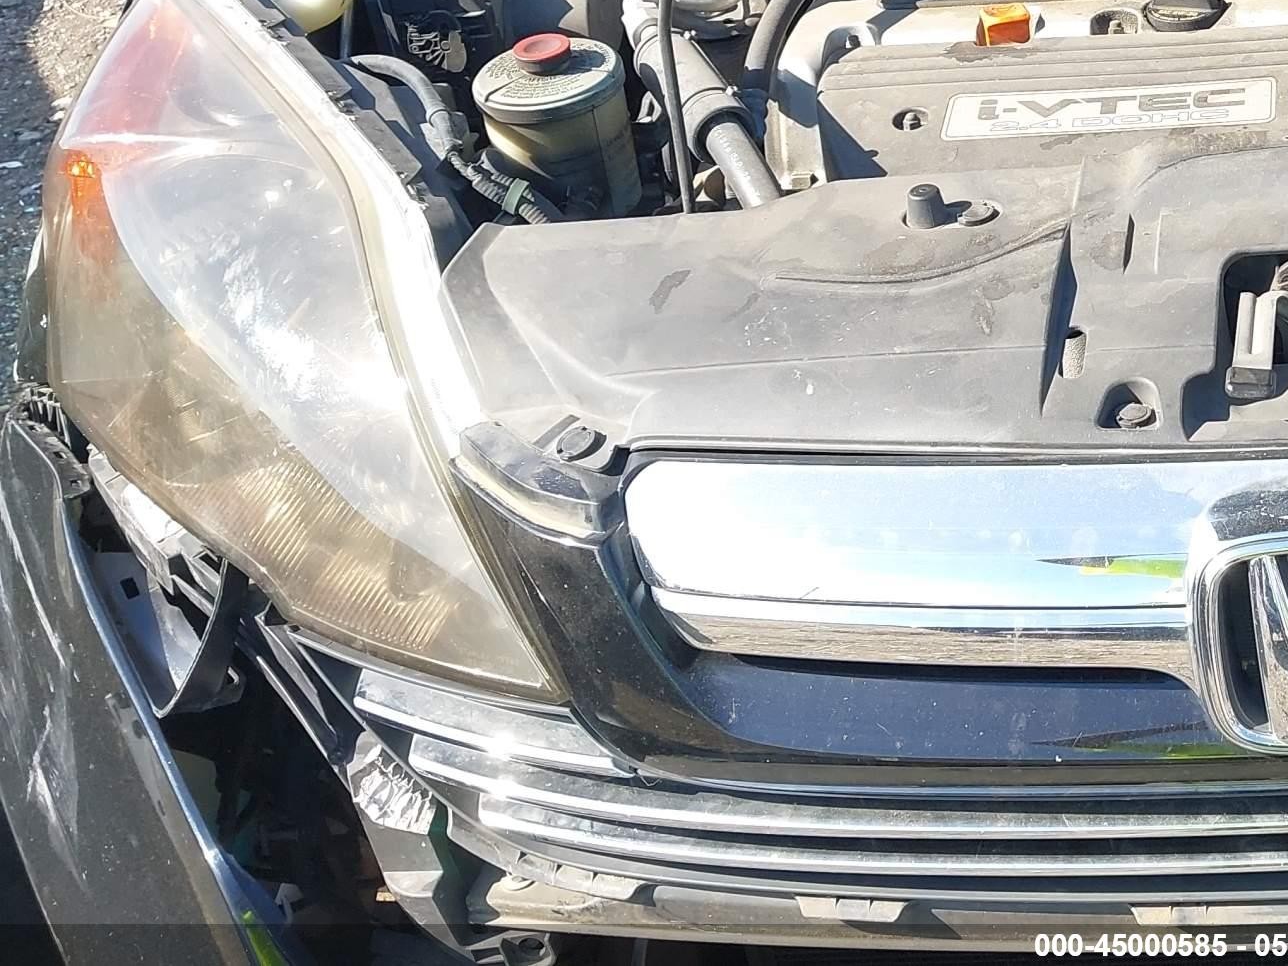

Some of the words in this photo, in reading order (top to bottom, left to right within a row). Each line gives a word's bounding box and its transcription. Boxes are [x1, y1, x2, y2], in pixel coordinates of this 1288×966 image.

[977, 87, 1246, 121] i-VTEC
[990, 117, 1062, 132] 2.4
[1071, 108, 1230, 129] DOHC
